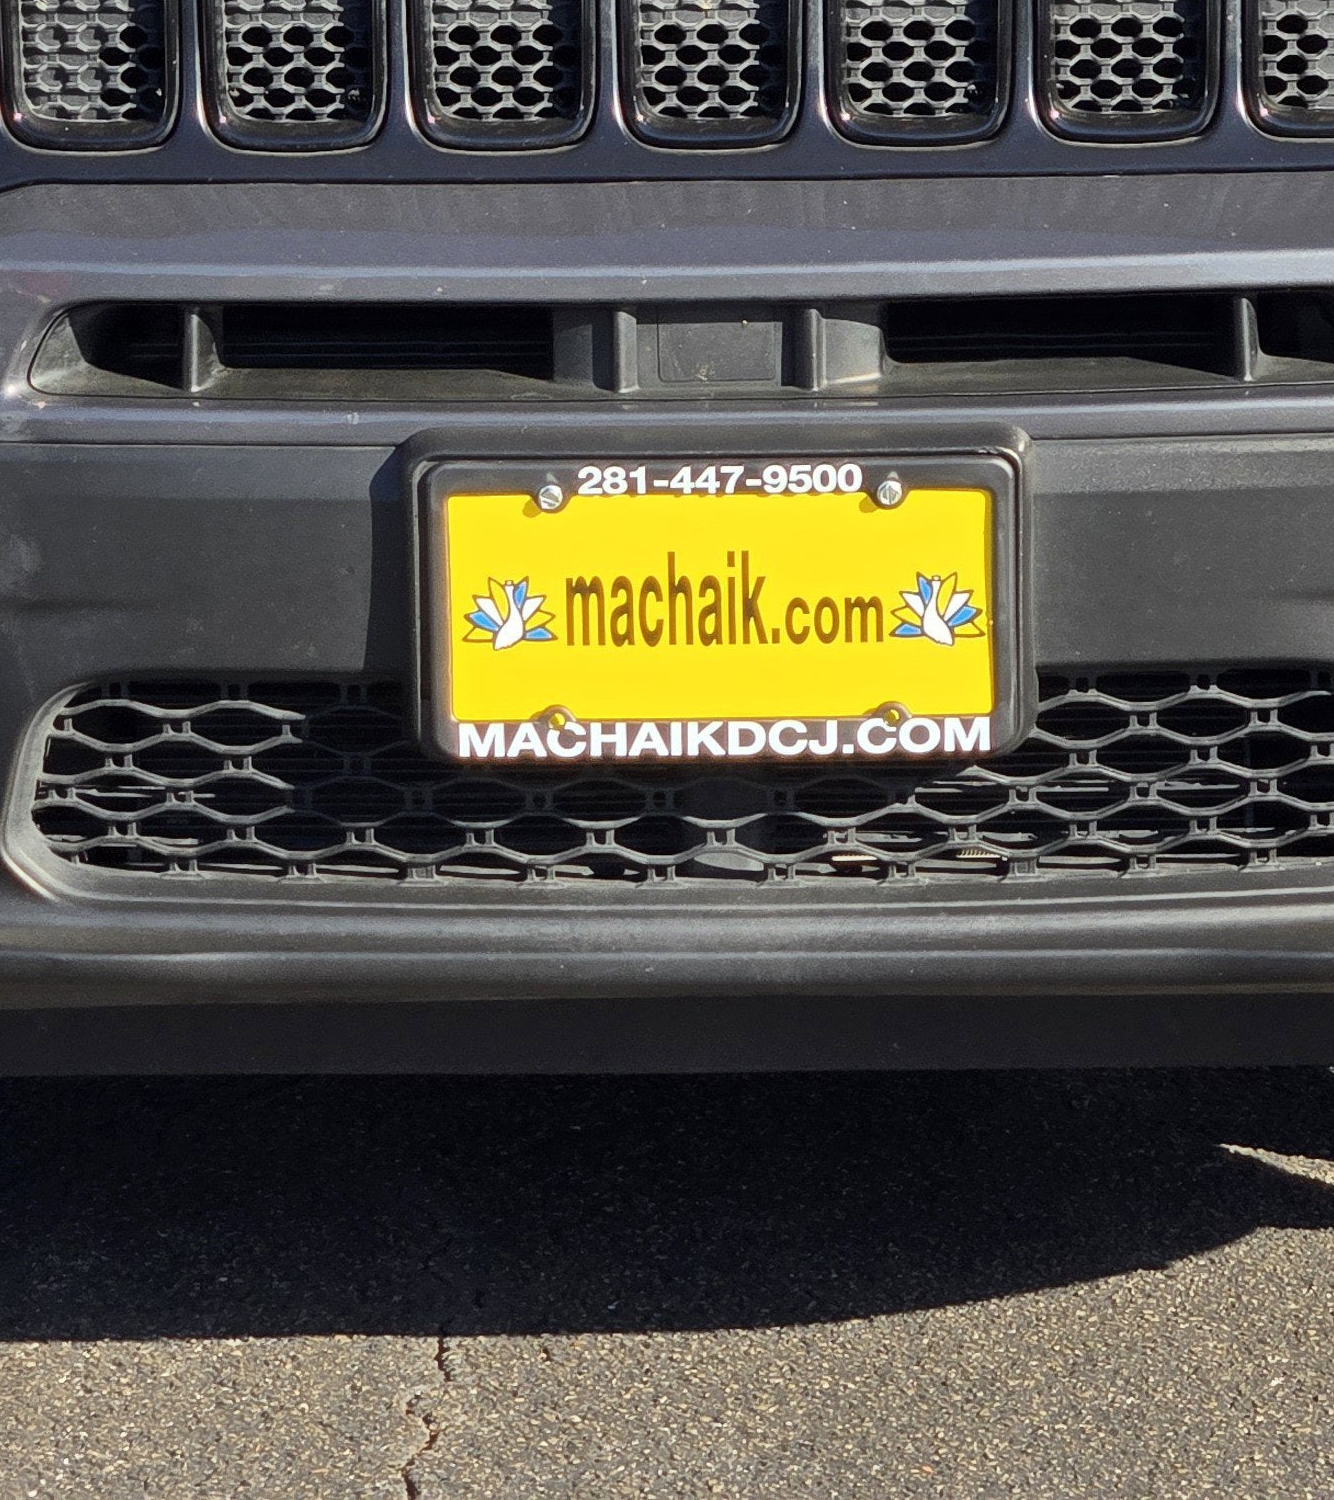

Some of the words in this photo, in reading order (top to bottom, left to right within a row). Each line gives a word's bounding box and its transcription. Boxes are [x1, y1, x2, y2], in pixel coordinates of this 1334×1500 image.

[577, 463, 863, 496] 281-447-9500
[564, 551, 885, 648] machaik.com
[457, 717, 992, 760] MACHAIKDCJ.COM
